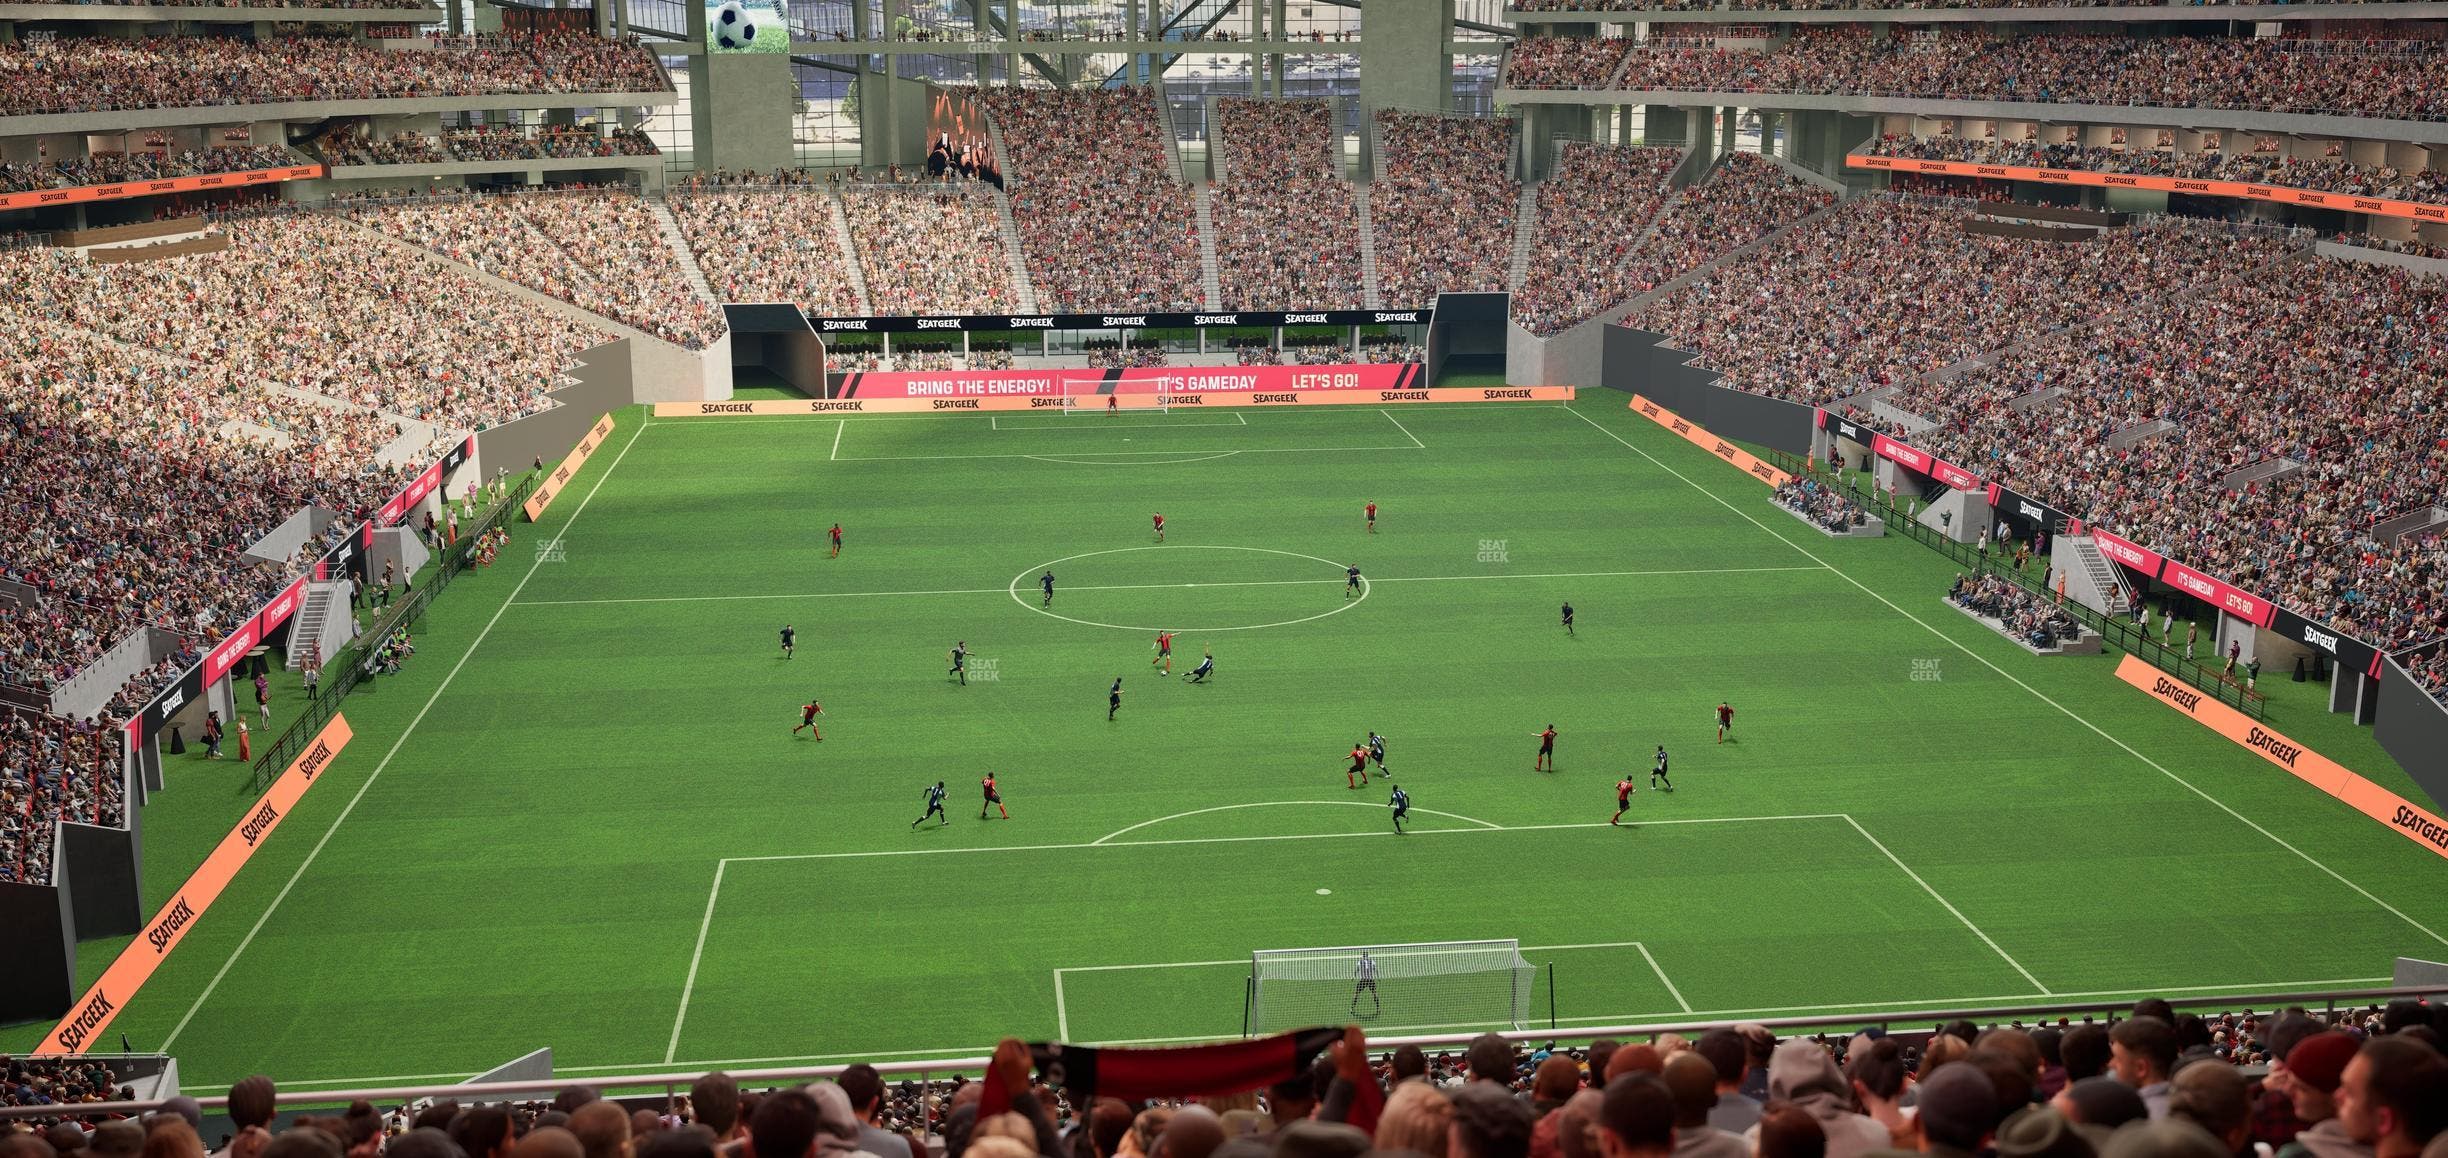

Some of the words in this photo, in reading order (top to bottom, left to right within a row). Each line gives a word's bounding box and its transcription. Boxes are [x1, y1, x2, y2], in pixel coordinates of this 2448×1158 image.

[1865, 158, 1891, 167] SEATGEEK
[1920, 162, 1947, 172] SEATGEEK
[246, 172, 268, 182] SEATGEEK
[290, 168, 311, 176] SEATGEEK
[1977, 166, 2006, 176] SEATGEEK
[2038, 171, 2069, 181] SEATGEEK
[150, 182, 174, 191] SEATGEEK
[200, 177, 223, 186] SEATGEEK
[2104, 176, 2136, 186] SEATGEEK
[2174, 180, 2209, 192] SEATGEEK
[40, 192, 69, 202] SEATGEEK
[97, 186, 124, 196] SEATGEEK
[2247, 186, 2272, 198] SEATGEEK
[2298, 192, 2324, 204] SEATGEEK
[2354, 199, 2382, 211] SEATGEEK
[2414, 206, 2445, 219] SEATGEEK
[1010, 317, 1054, 328] SEATGEEK
[1102, 316, 1146, 326] SEATGEEK
[1194, 314, 1238, 326] SEATGEEK
[1284, 313, 1328, 324] SEATGEEK
[1374, 312, 1418, 322] SEATGEEK
[823, 319, 868, 330] SEATGEEK
[917, 318, 962, 329] SEATGEEK
[907, 380, 953, 396] BRING
[959, 380, 983, 394] THE
[988, 378, 1051, 394] ENERGY!
[1158, 376, 1184, 391] IT'S
[1188, 375, 1258, 390] GAMEDAY
[1292, 374, 1331, 389] LET'S
[1334, 373, 1359, 388] GO!
[1253, 393, 1298, 404] SEATGEEK
[1381, 390, 1430, 401] SEATGEEK
[1484, 389, 1532, 400] SEATGEEK
[812, 401, 863, 412] SEATGEEK
[933, 398, 980, 409] SEATGEEK
[1031, 396, 1076, 408] SEATGEEK
[702, 403, 753, 414] SEATGEEK
[1642, 402, 1660, 419] SEATGEEK
[1672, 418, 1692, 436] SEATGEEK
[1714, 441, 1736, 460] SEATGEEK
[1752, 461, 1775, 482] SEATGEEK
[2020, 500, 2044, 522] SEATGEEK
[2114, 542, 2124, 558] THE
[2122, 546, 2144, 566] ENERGY!
[2177, 571, 2189, 587] IT'S
[2188, 575, 2215, 598] GAMEDAY
[2225, 592, 2242, 609] LET'S
[2242, 600, 2254, 616] GO!
[2304, 624, 2339, 655] SEATGEEK
[2152, 676, 2202, 714] SEATGEEK
[162, 686, 184, 719] SEATGEEK
[2246, 726, 2302, 768] SEATGEEK
[299, 738, 332, 780] SEATGEEK
[241, 798, 279, 847] SEATGEEK
[2392, 805, 2448, 850] SEATGEE
[148, 896, 195, 954] SEATGEEK
[58, 988, 115, 1054] SEATGEEK
